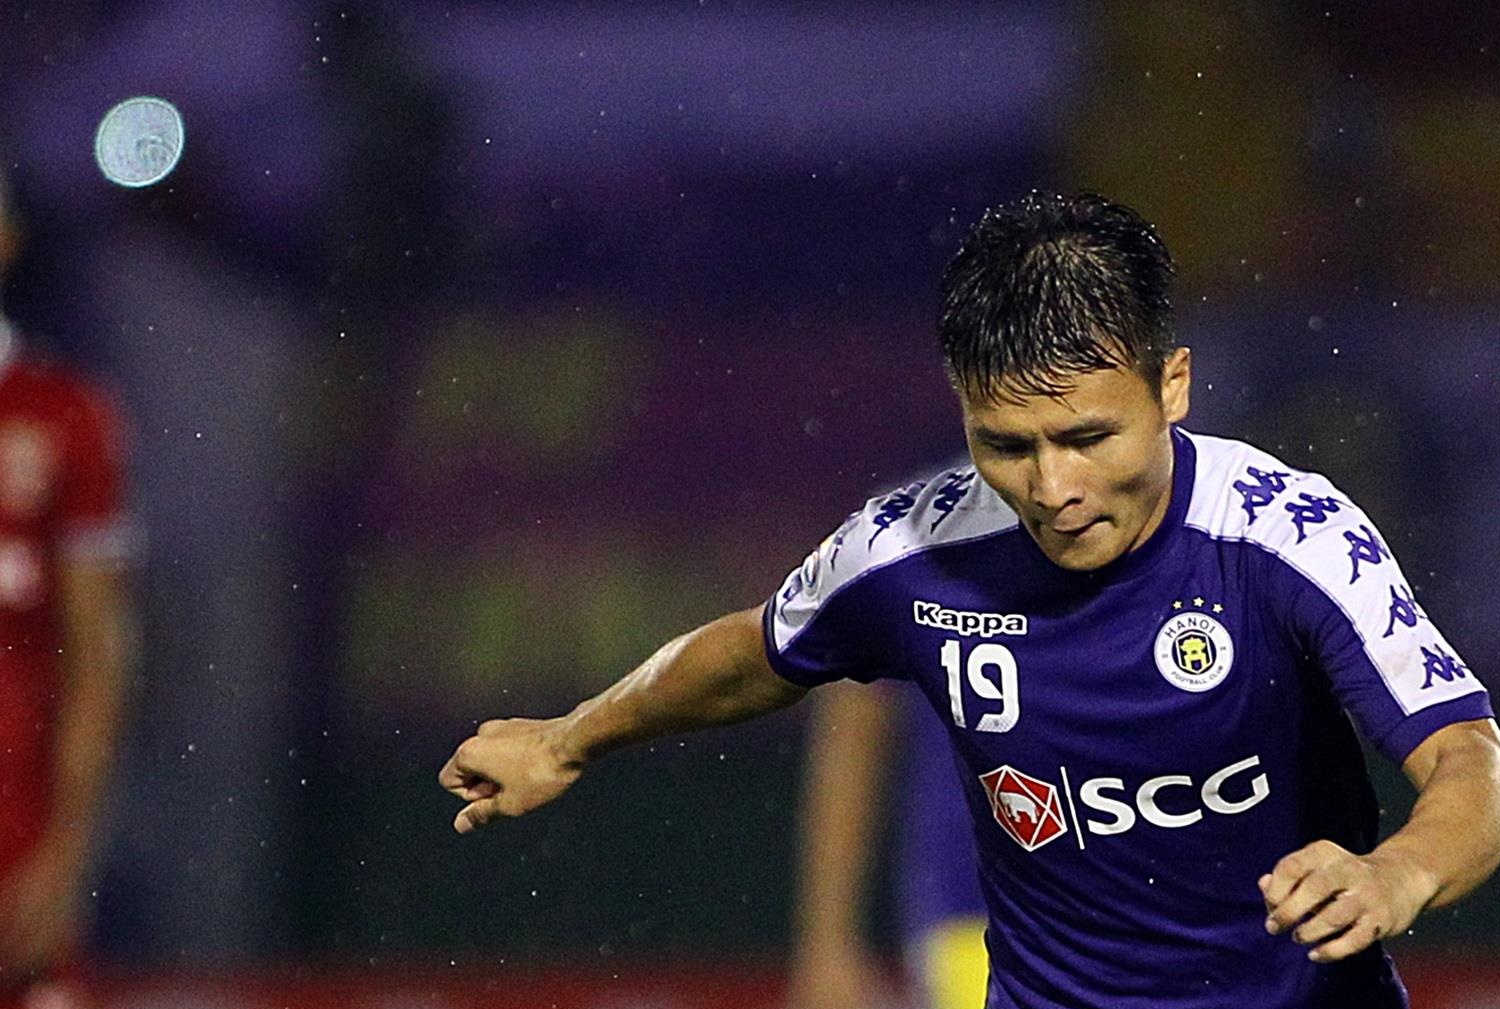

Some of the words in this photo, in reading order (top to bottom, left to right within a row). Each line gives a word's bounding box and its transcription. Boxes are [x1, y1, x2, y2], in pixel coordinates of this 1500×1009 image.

[912, 600, 1028, 637] Kappa
[1164, 616, 1216, 639] HANOI
[940, 639, 1020, 733] 19
[1080, 755, 1270, 835] SCG
